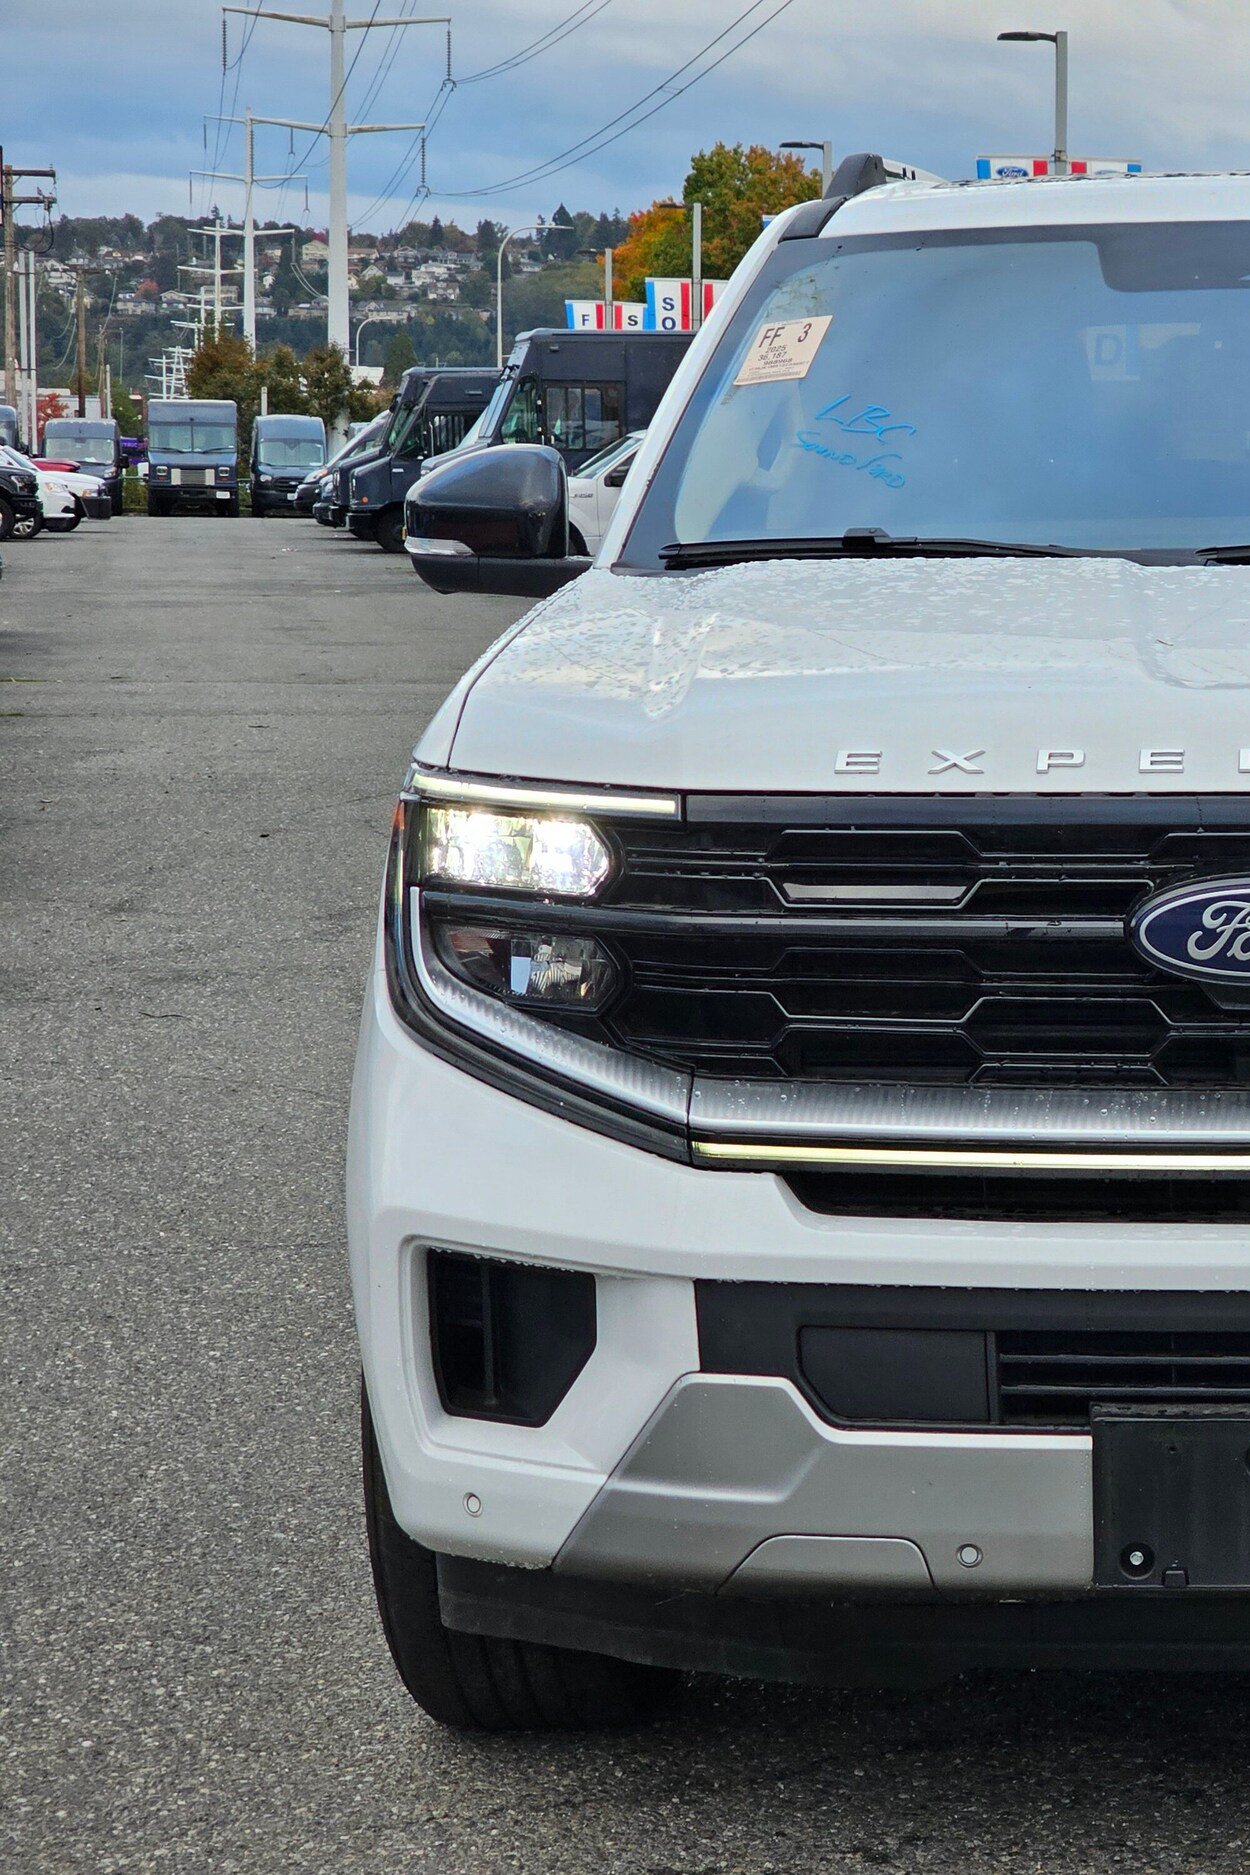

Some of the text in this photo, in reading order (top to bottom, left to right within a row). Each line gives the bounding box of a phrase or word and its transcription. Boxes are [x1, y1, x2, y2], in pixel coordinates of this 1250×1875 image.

[758, 322, 812, 348] FF 3
[765, 344, 788, 354] 2025
